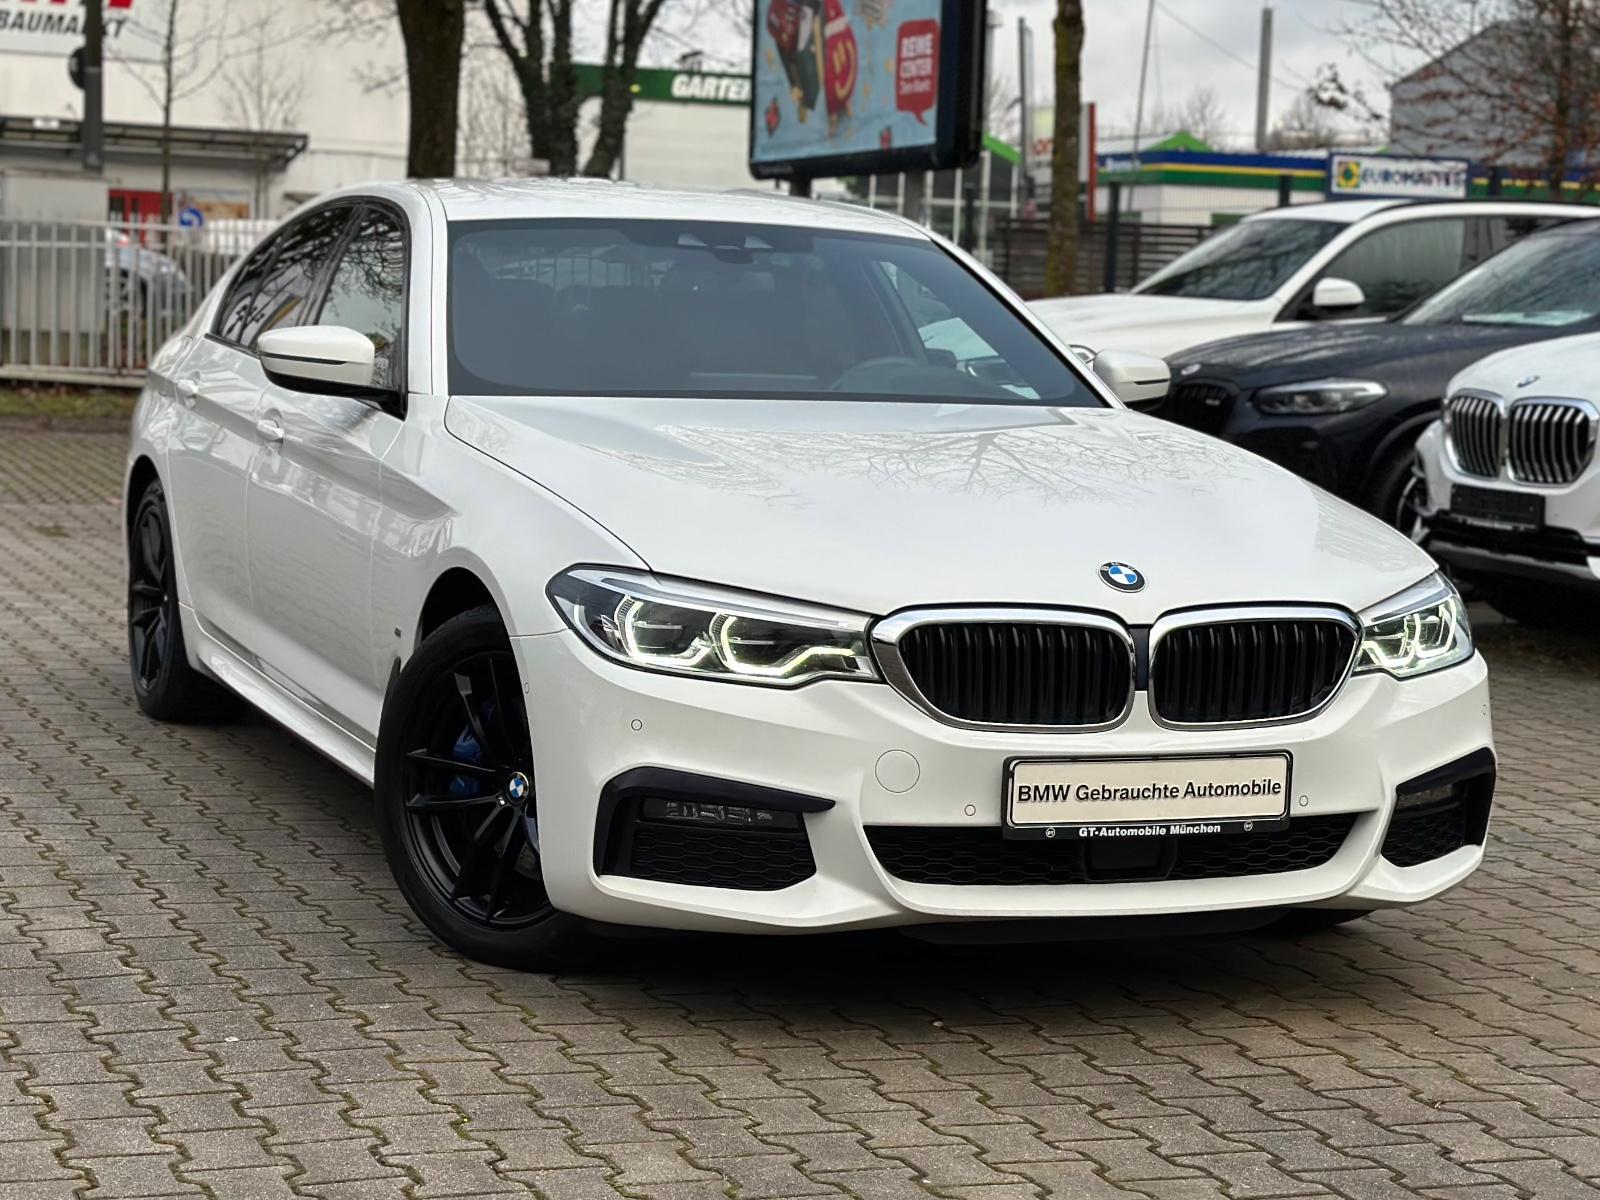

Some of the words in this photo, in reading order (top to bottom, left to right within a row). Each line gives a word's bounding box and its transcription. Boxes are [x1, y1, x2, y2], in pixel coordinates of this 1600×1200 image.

[1017, 784, 1071, 802] BMW
[1075, 783, 1180, 801] Gebrauchte
[1182, 779, 1282, 799] Automobile
[1079, 826, 1167, 837] GT-Automobile
[1170, 824, 1221, 835] München
